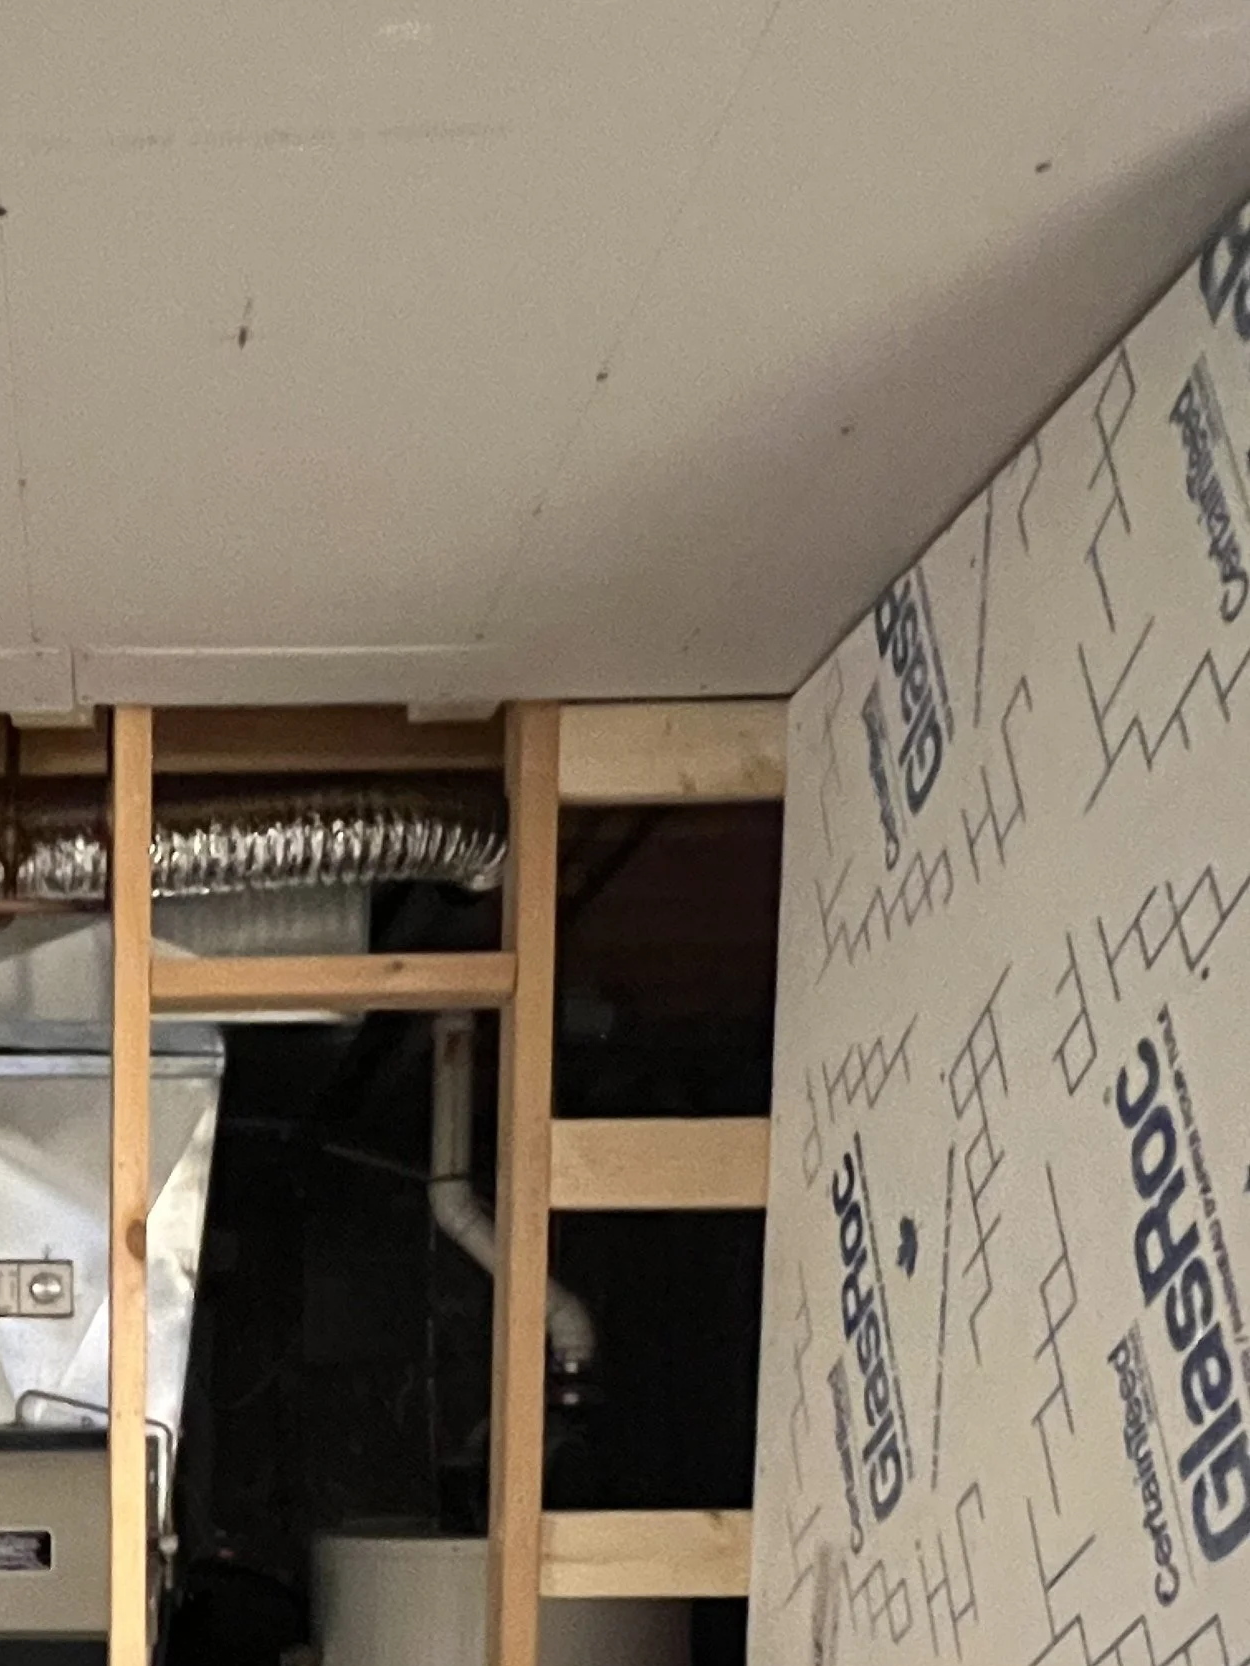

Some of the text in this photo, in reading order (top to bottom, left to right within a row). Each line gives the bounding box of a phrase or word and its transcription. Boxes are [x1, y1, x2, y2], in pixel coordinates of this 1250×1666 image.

[832, 1151, 904, 1524] GlasRoc
[1107, 1338, 1180, 1607] CertainTeed
[1116, 1036, 1250, 1564] GlasRoc
